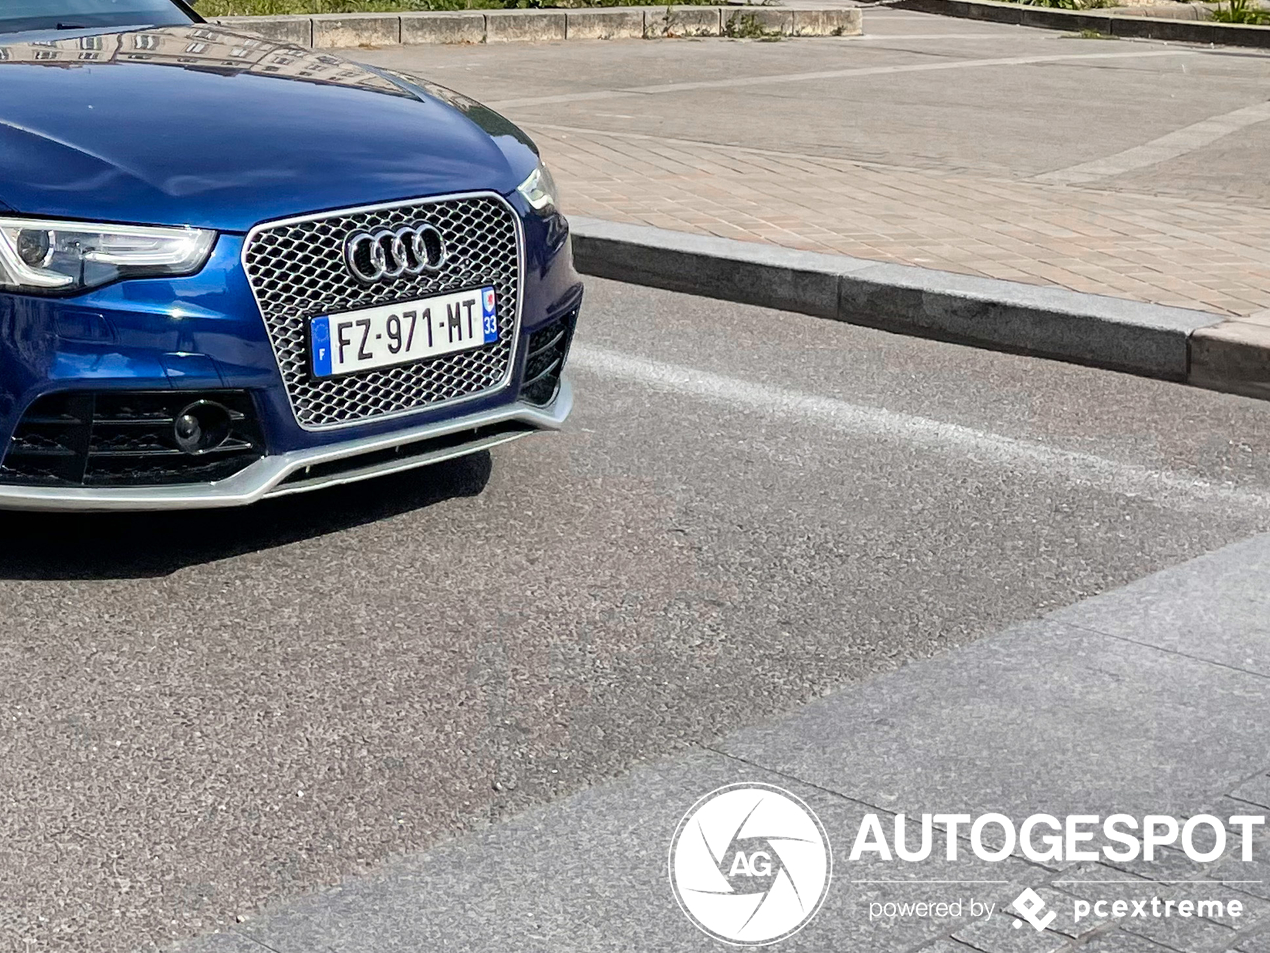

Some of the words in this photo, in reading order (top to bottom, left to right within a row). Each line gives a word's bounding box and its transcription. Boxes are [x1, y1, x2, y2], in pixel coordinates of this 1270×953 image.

[337, 299, 476, 363] FZ-971-MT
[483, 315, 497, 335] 33
[318, 349, 326, 361] F
